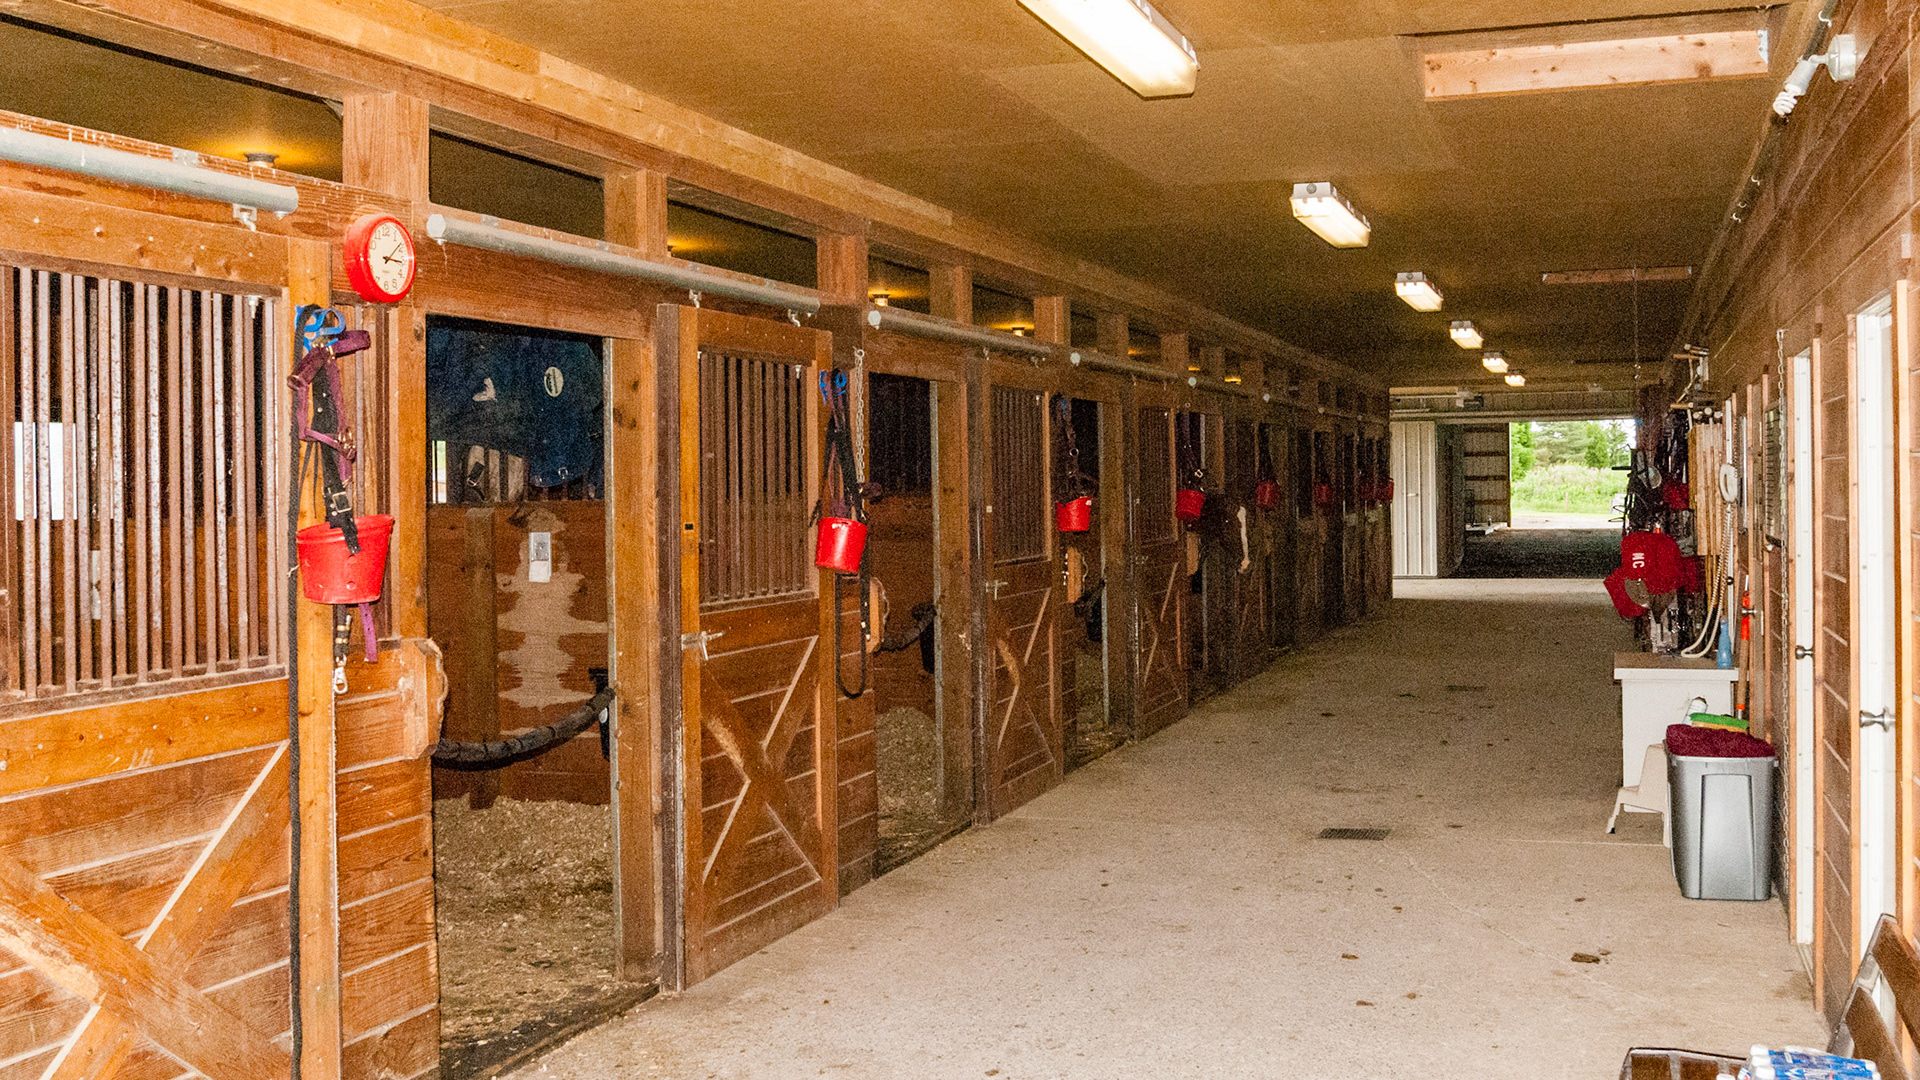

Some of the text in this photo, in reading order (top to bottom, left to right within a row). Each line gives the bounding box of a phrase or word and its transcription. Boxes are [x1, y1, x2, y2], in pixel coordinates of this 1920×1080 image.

[375, 230, 381, 240] 11
[382, 226, 390, 236] 12
[384, 280, 389, 290] 6
[1632, 552, 1645, 568] MC
